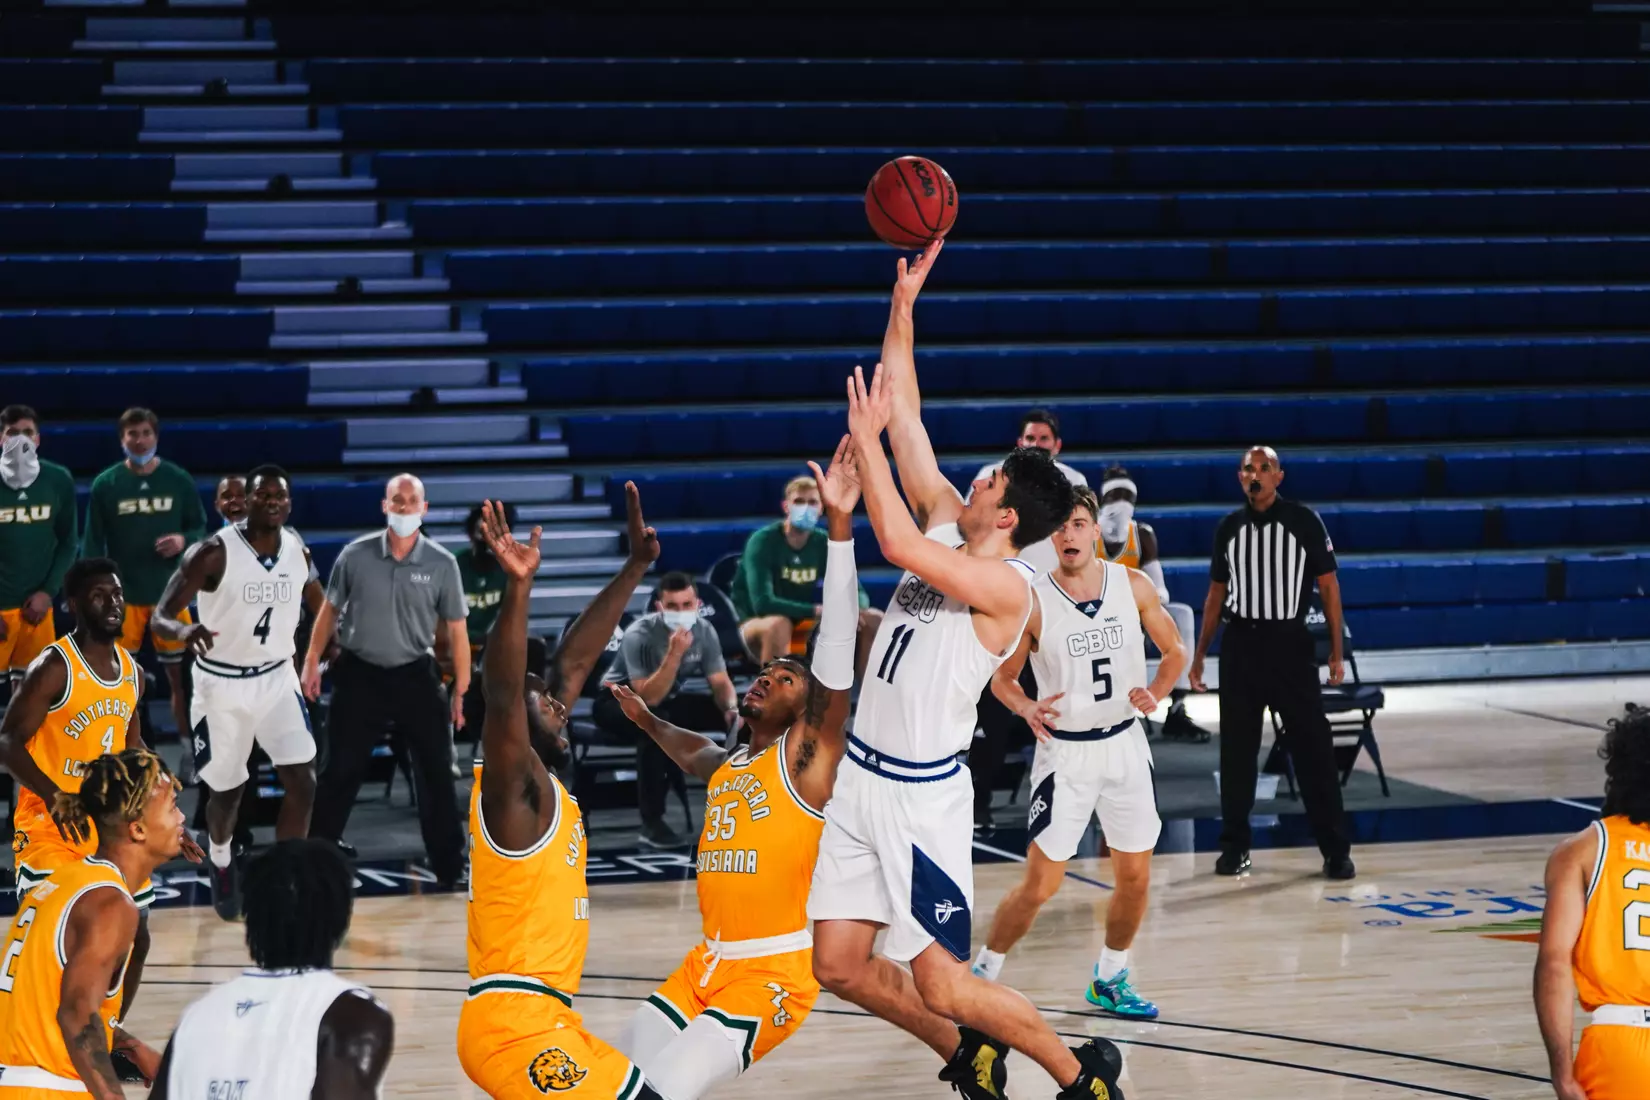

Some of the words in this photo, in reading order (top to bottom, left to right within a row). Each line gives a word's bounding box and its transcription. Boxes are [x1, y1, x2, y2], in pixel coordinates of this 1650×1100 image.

[0, 504, 52, 524] SLU
[117, 496, 173, 516] SLU
[243, 581, 293, 605] CBU
[896, 575, 945, 624] CBU
[252, 606, 274, 646] 4
[1066, 625, 1124, 658] CBU
[876, 623, 916, 685] 11
[1091, 657, 1113, 703] 5
[100, 725, 115, 755] 4
[705, 799, 740, 842] 35
